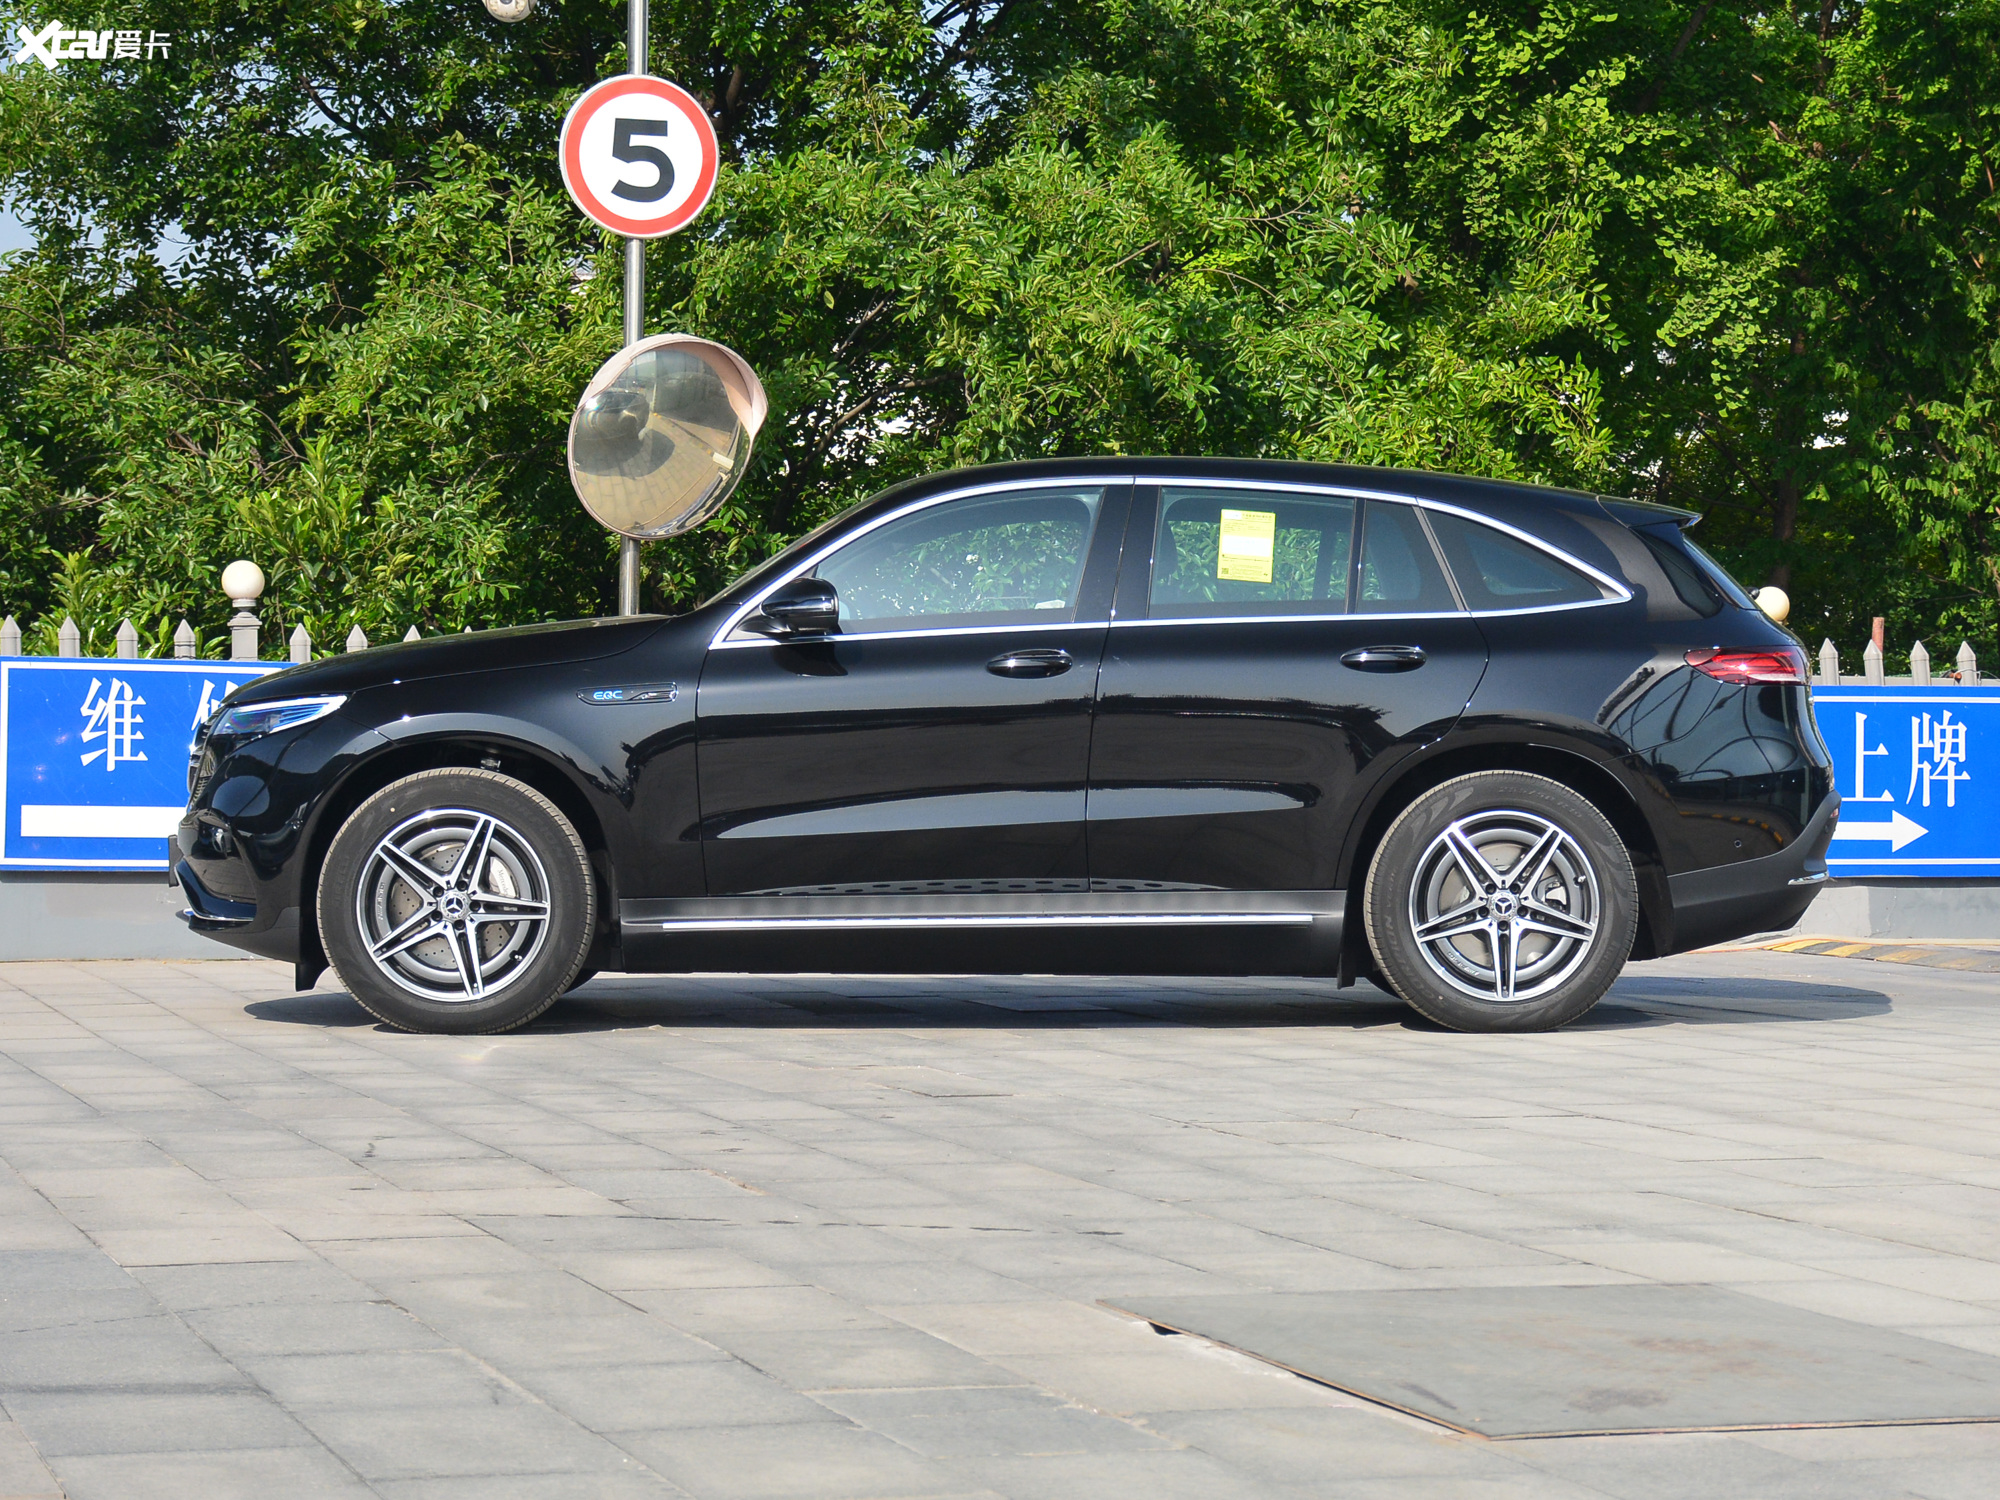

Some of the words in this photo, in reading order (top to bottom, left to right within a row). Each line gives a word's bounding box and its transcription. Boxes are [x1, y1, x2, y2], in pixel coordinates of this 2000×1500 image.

[611, 118, 675, 203] 5
[593, 690, 623, 700] EQC
[1841, 709, 1971, 808] 上牌
